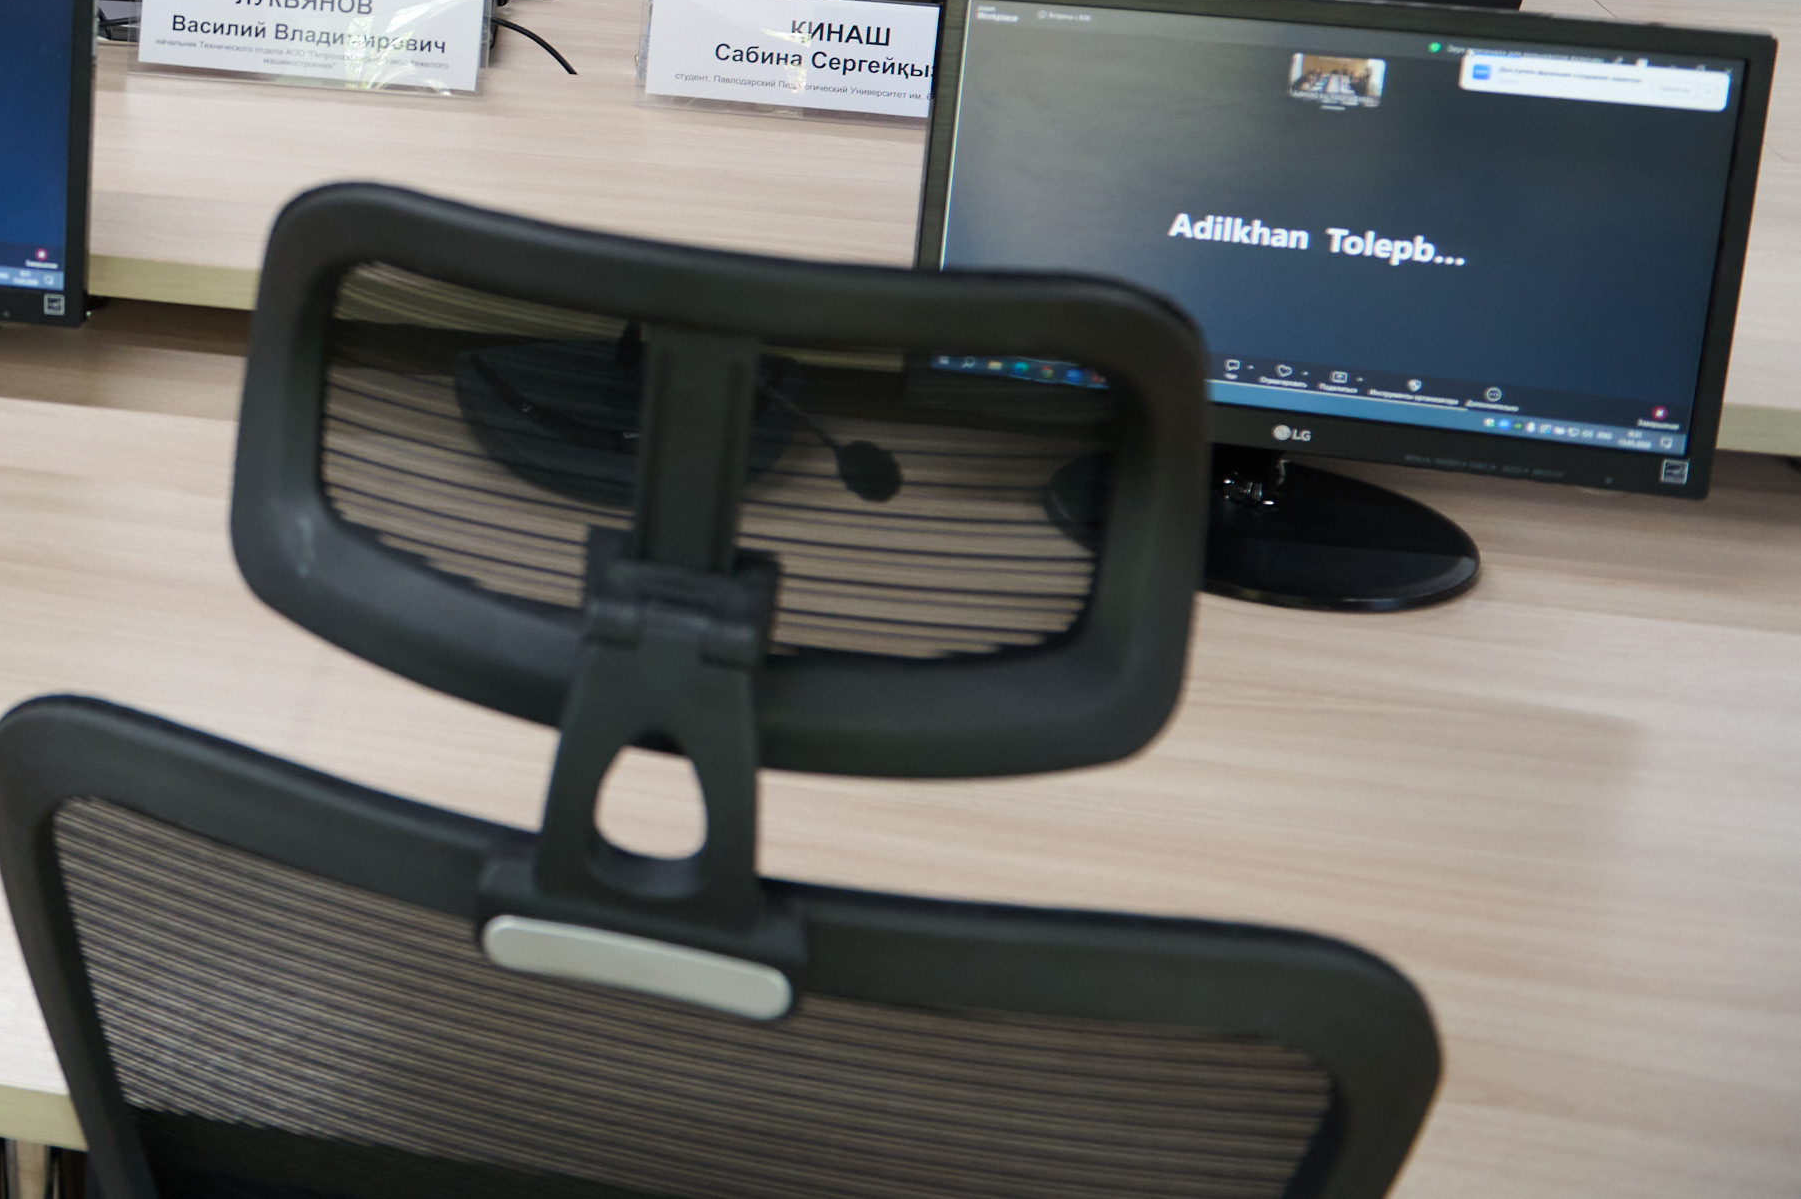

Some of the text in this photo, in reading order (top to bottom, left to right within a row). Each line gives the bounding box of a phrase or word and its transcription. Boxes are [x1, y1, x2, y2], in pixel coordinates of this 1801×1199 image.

[172, 14, 266, 39] Василий
[199, 41, 253, 53] Технического
[715, 43, 935, 80] Сабина Сергейқы
[674, 73, 711, 83] студент,
[714, 74, 776, 88] Павлодарский
[778, 80, 848, 94] Педогический
[850, 87, 907, 99] Университет
[1167, 213, 1467, 266] Adilkhan Tolepb...
